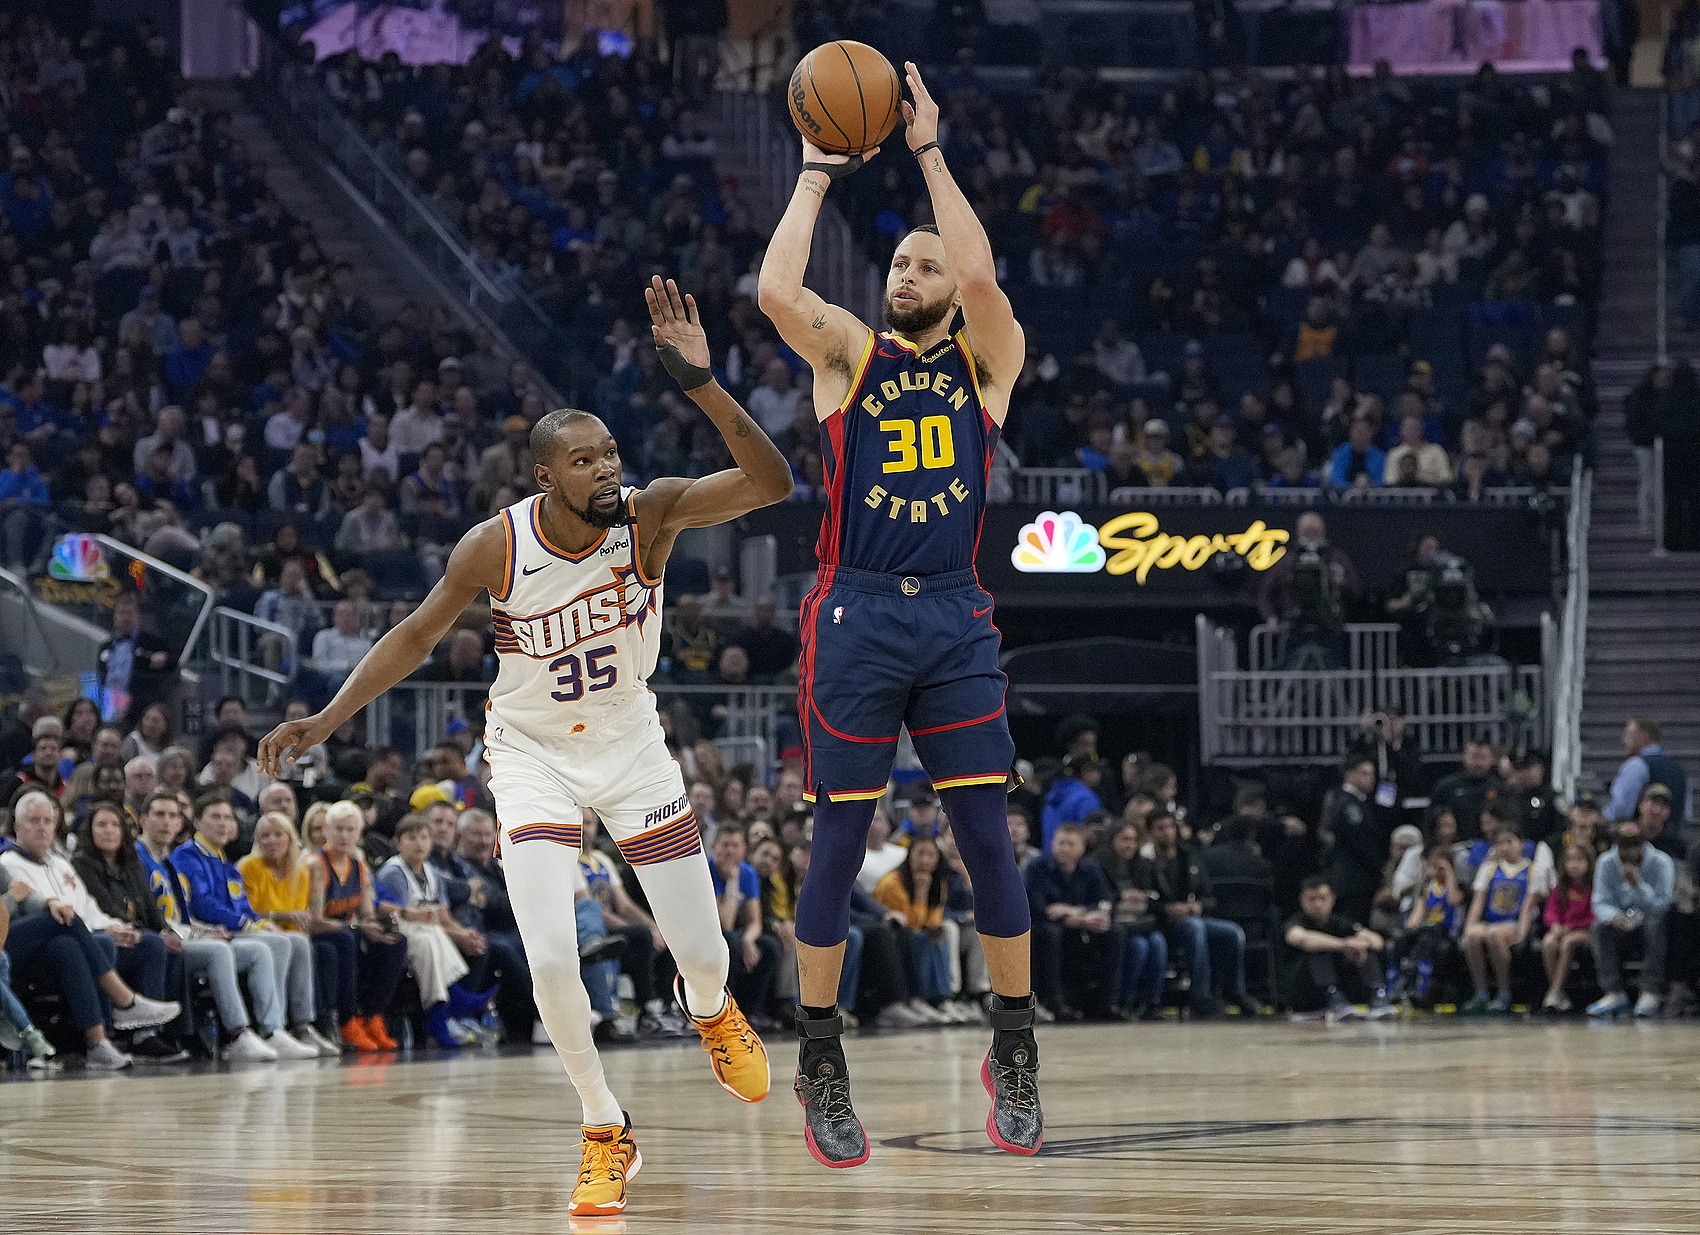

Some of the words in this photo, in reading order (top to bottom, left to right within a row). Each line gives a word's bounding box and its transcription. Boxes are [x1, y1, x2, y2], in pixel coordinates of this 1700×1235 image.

[921, 343, 955, 364] Rakuten
[861, 371, 969, 418] GOLDEN
[879, 415, 955, 474] 30
[864, 477, 970, 523] STATE
[599, 538, 629, 557] PayPal
[1098, 512, 1290, 585] Sports
[511, 588, 621, 657] SUNS
[549, 645, 618, 703] 35
[644, 792, 688, 829] PHOENI
